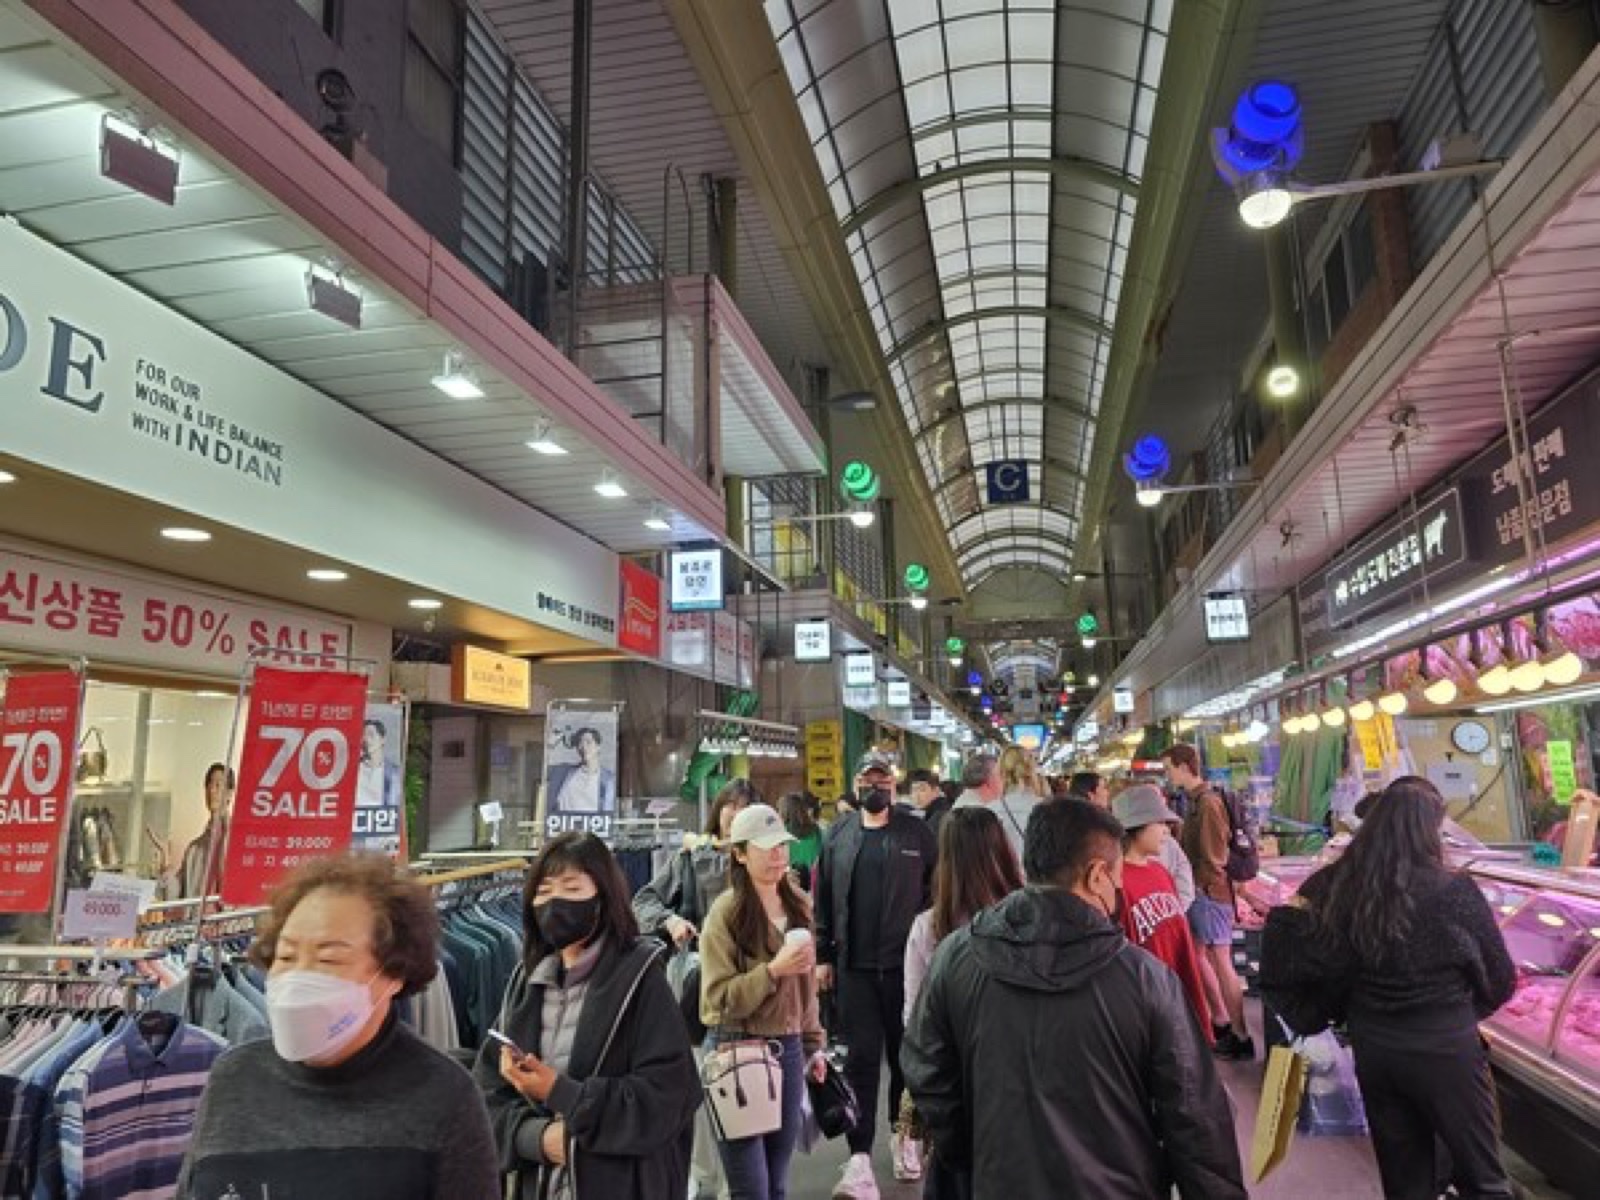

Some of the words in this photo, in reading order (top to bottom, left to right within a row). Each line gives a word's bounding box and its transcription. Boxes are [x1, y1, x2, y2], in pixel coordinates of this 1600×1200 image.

[136, 359, 167, 386] FOR
[170, 374, 201, 401] OUR
[132, 411, 170, 442] WITH
[175, 423, 282, 486] INDIAN
[135, 380, 179, 415] WORK
[183, 405, 193, 422] &
[197, 410, 225, 436] LIFE
[229, 424, 284, 461] BALANCE
[0, 570, 124, 638] 신상품
[142, 599, 234, 654] 50%
[249, 620, 339, 668] SALE
[0, 730, 62, 796] 70
[257, 725, 348, 790] 70
[251, 792, 340, 820] SALE
[352, 809, 398, 833] 디안
[546, 814, 612, 838] 인디안
